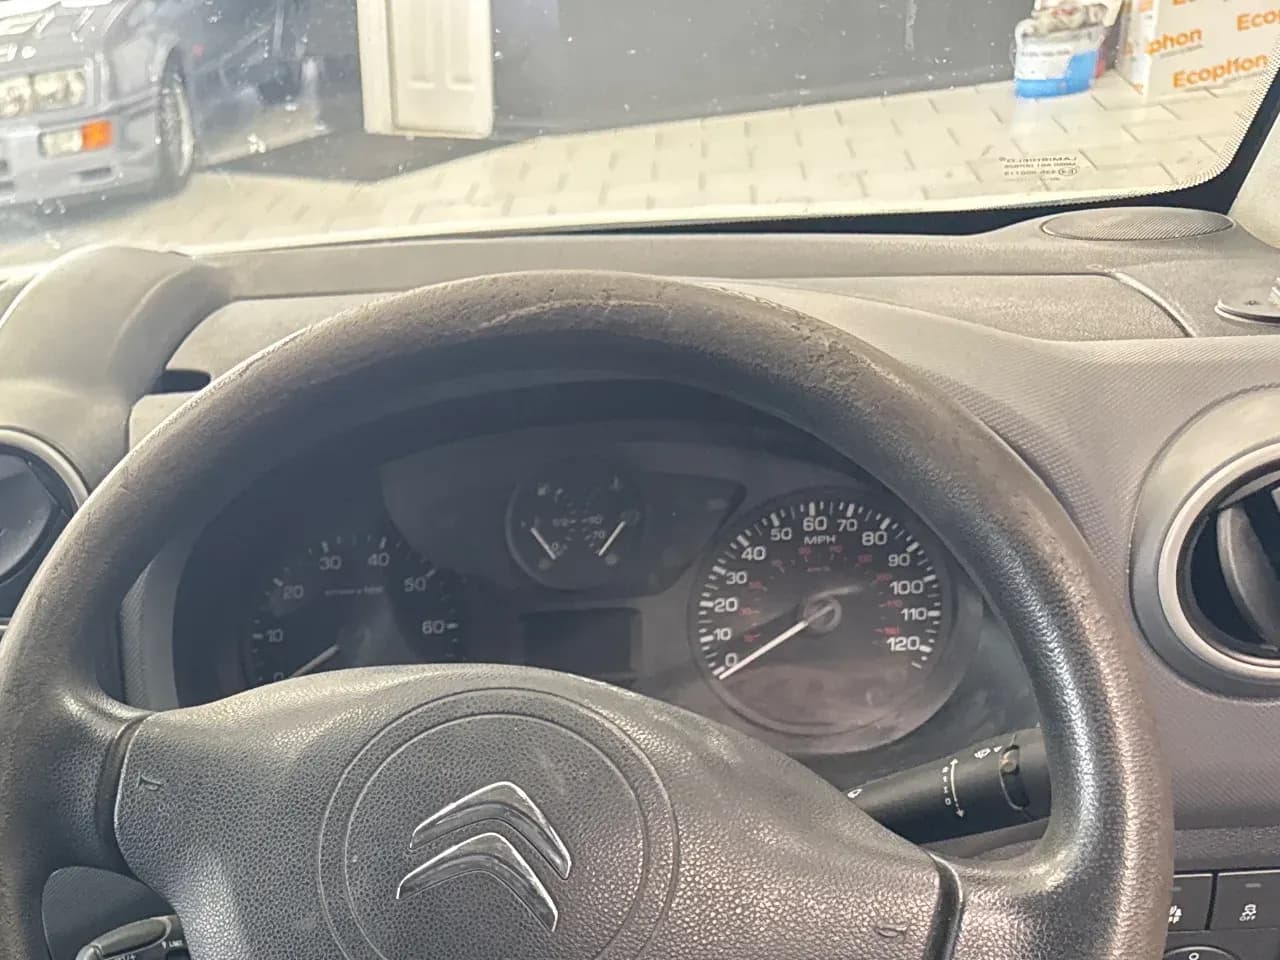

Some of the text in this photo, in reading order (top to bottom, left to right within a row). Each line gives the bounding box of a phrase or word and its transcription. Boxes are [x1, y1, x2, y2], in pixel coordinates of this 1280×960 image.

[1236, 9, 1280, 32] Eco
[1173, 55, 1268, 88] Ecophon
[803, 517, 827, 531] 60
[837, 519, 858, 532] 70
[770, 528, 792, 541] 50
[803, 534, 837, 545] MPH
[862, 531, 888, 546] 80
[368, 552, 390, 567] 40
[741, 546, 767, 561] 40
[888, 553, 911, 567] 90
[319, 555, 342, 570] 30
[404, 576, 427, 592] 50
[725, 571, 748, 585] 30
[282, 584, 304, 600] 20
[889, 580, 925, 595] 100
[714, 597, 739, 612] 20
[900, 607, 928, 621] 110
[422, 620, 445, 634] 60
[713, 627, 732, 641] 10
[267, 628, 284, 643] 10
[886, 636, 921, 651] 120
[725, 652, 738, 667] 0
